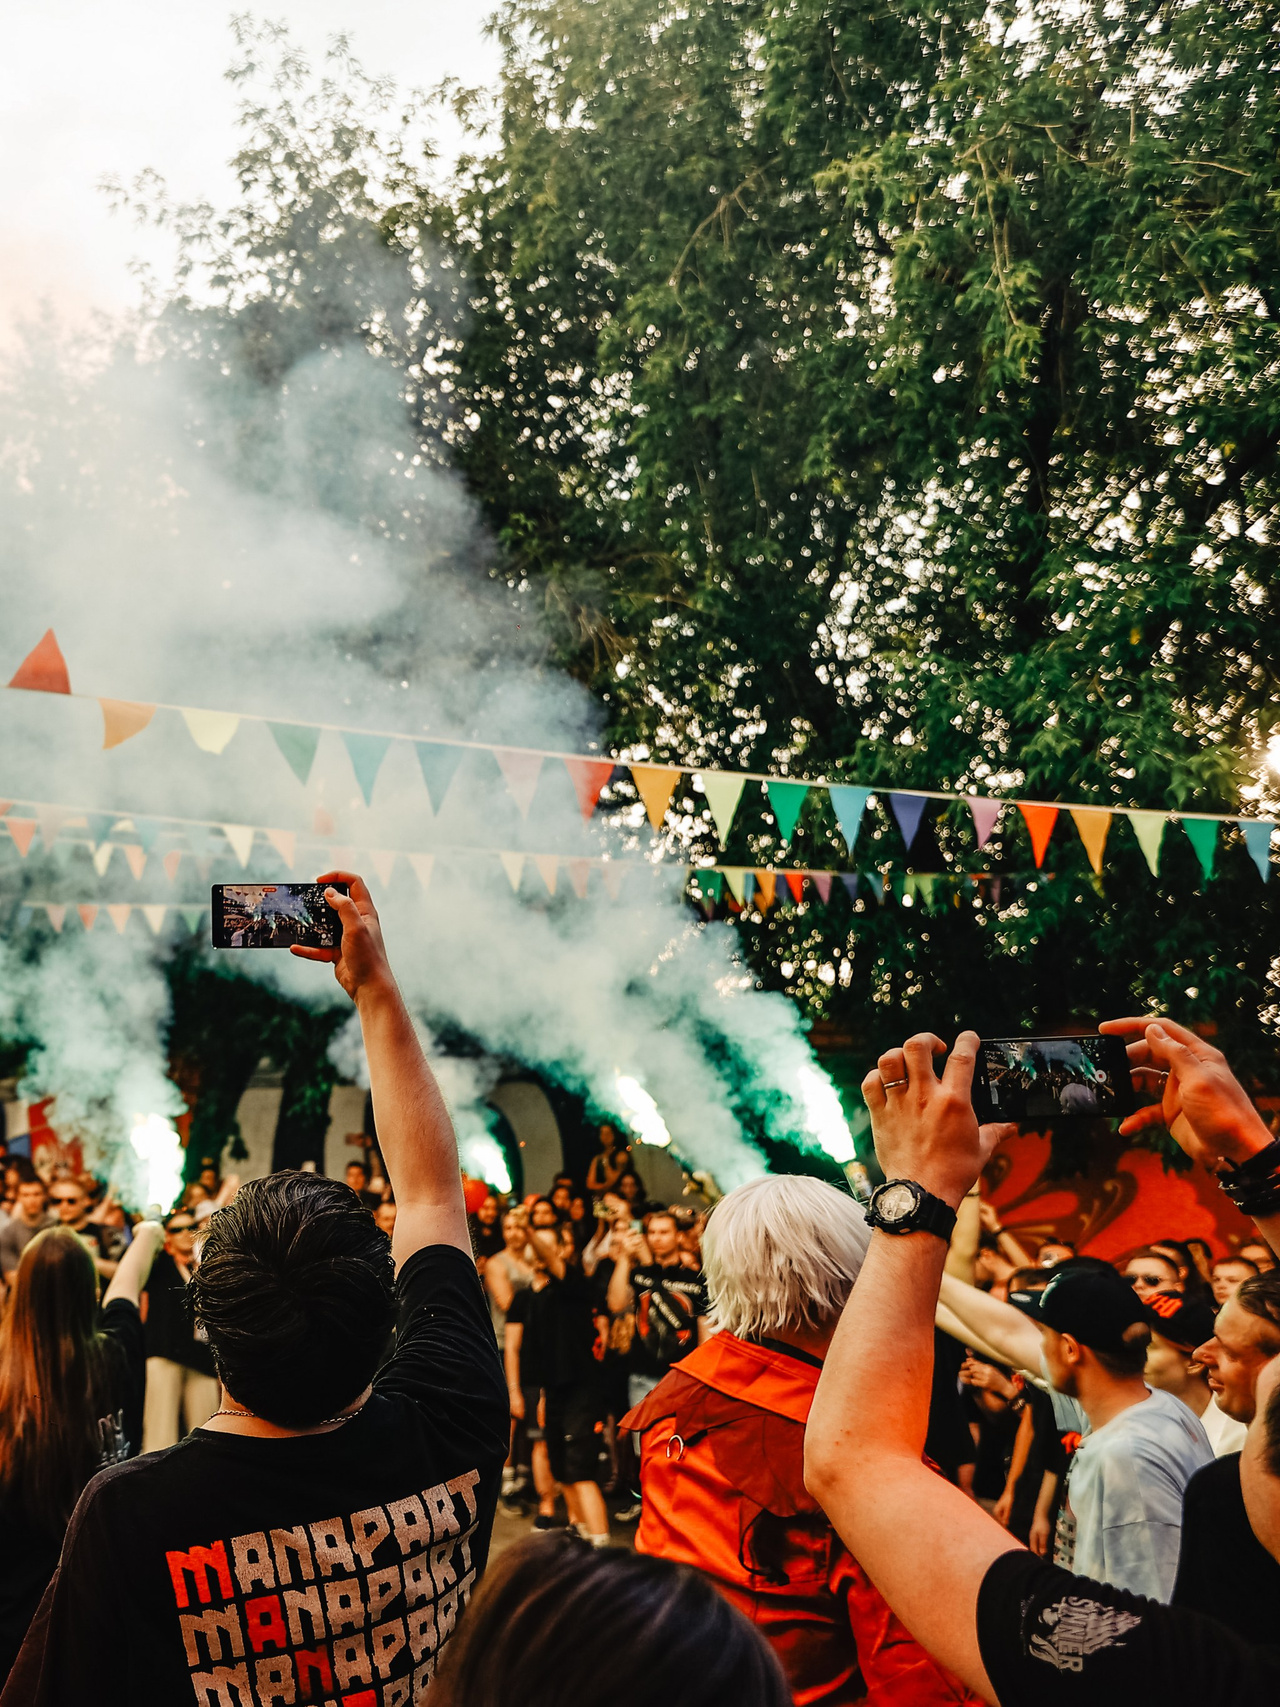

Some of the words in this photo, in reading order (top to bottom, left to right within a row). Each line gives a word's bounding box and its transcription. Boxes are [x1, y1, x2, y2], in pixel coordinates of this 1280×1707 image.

[166, 1468, 481, 1608] MANAPART
[179, 1520, 480, 1667] MANAPART
[1057, 1596, 1098, 1673] SINNER
